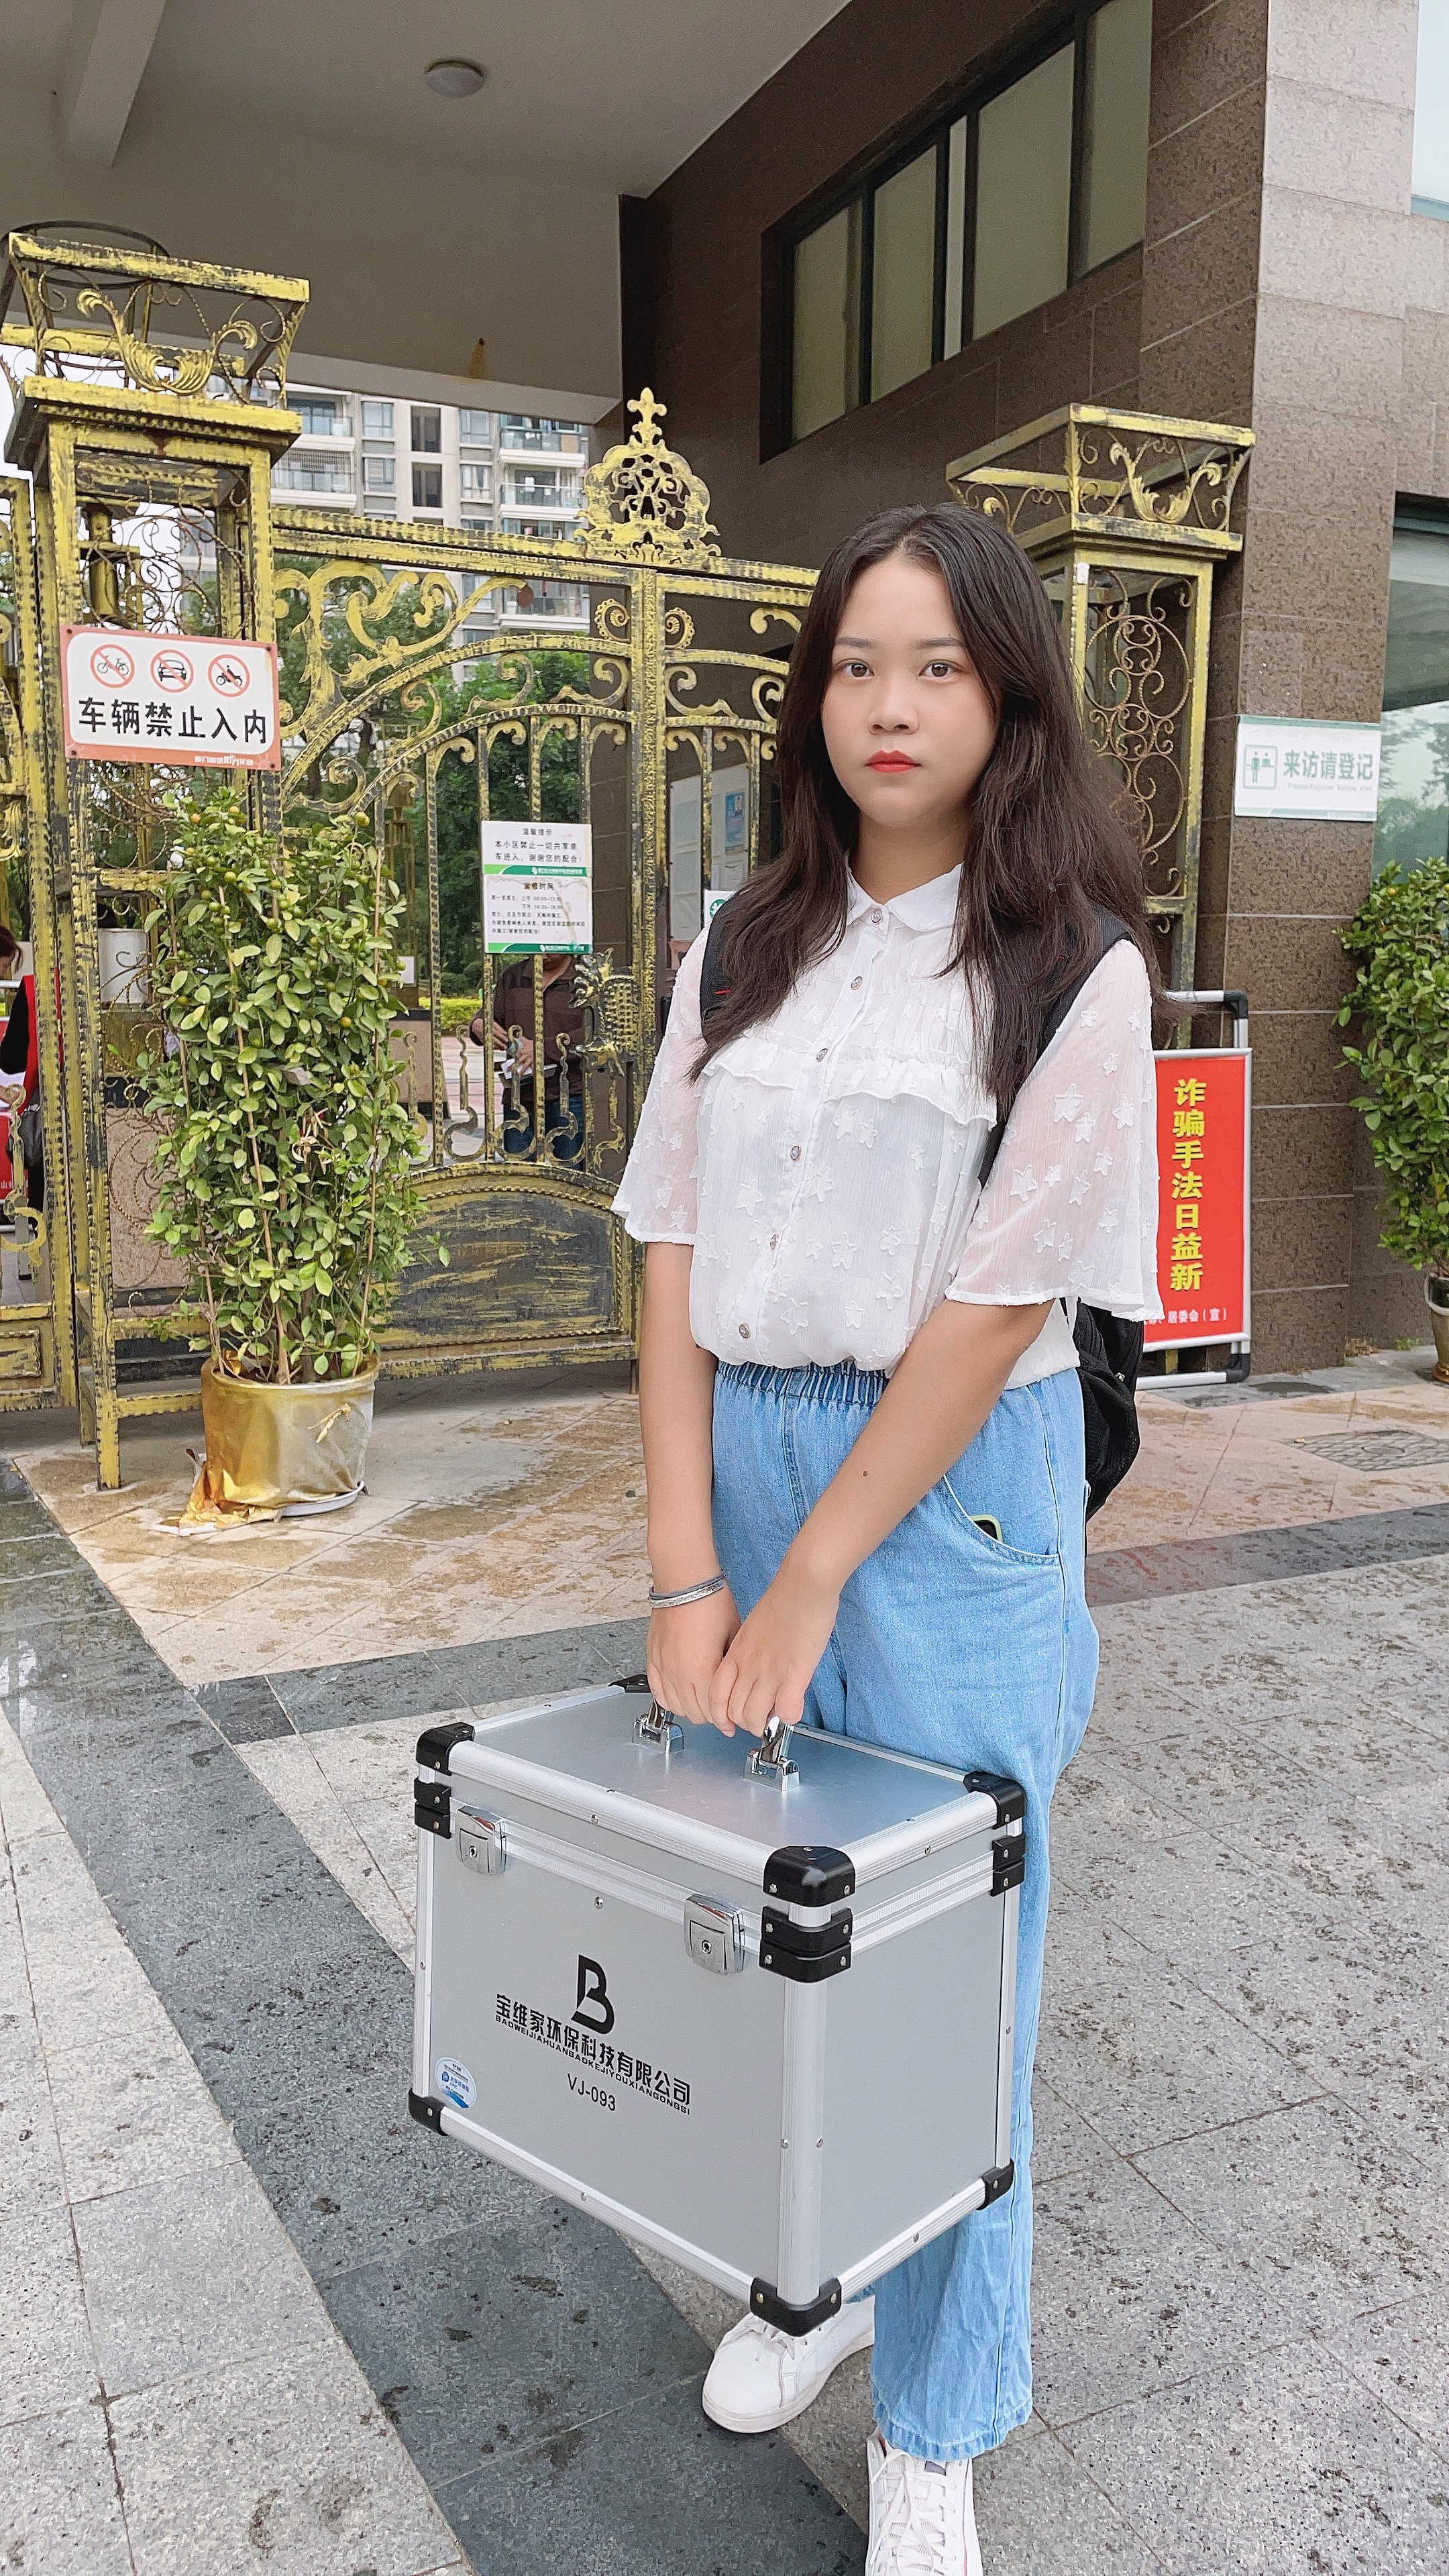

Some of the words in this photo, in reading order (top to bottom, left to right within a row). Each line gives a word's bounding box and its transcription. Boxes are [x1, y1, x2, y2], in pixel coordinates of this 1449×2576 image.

[78, 697, 266, 744] 车辆禁止入内
[1283, 749, 1373, 780] 来访请登记
[1170, 1077, 1207, 1292] 诈骗手法日益新
[571, 1954, 614, 2034] B
[496, 1993, 691, 2106] 宝维家环保科技有限公司
[567, 2073, 616, 2112] VJ-093
